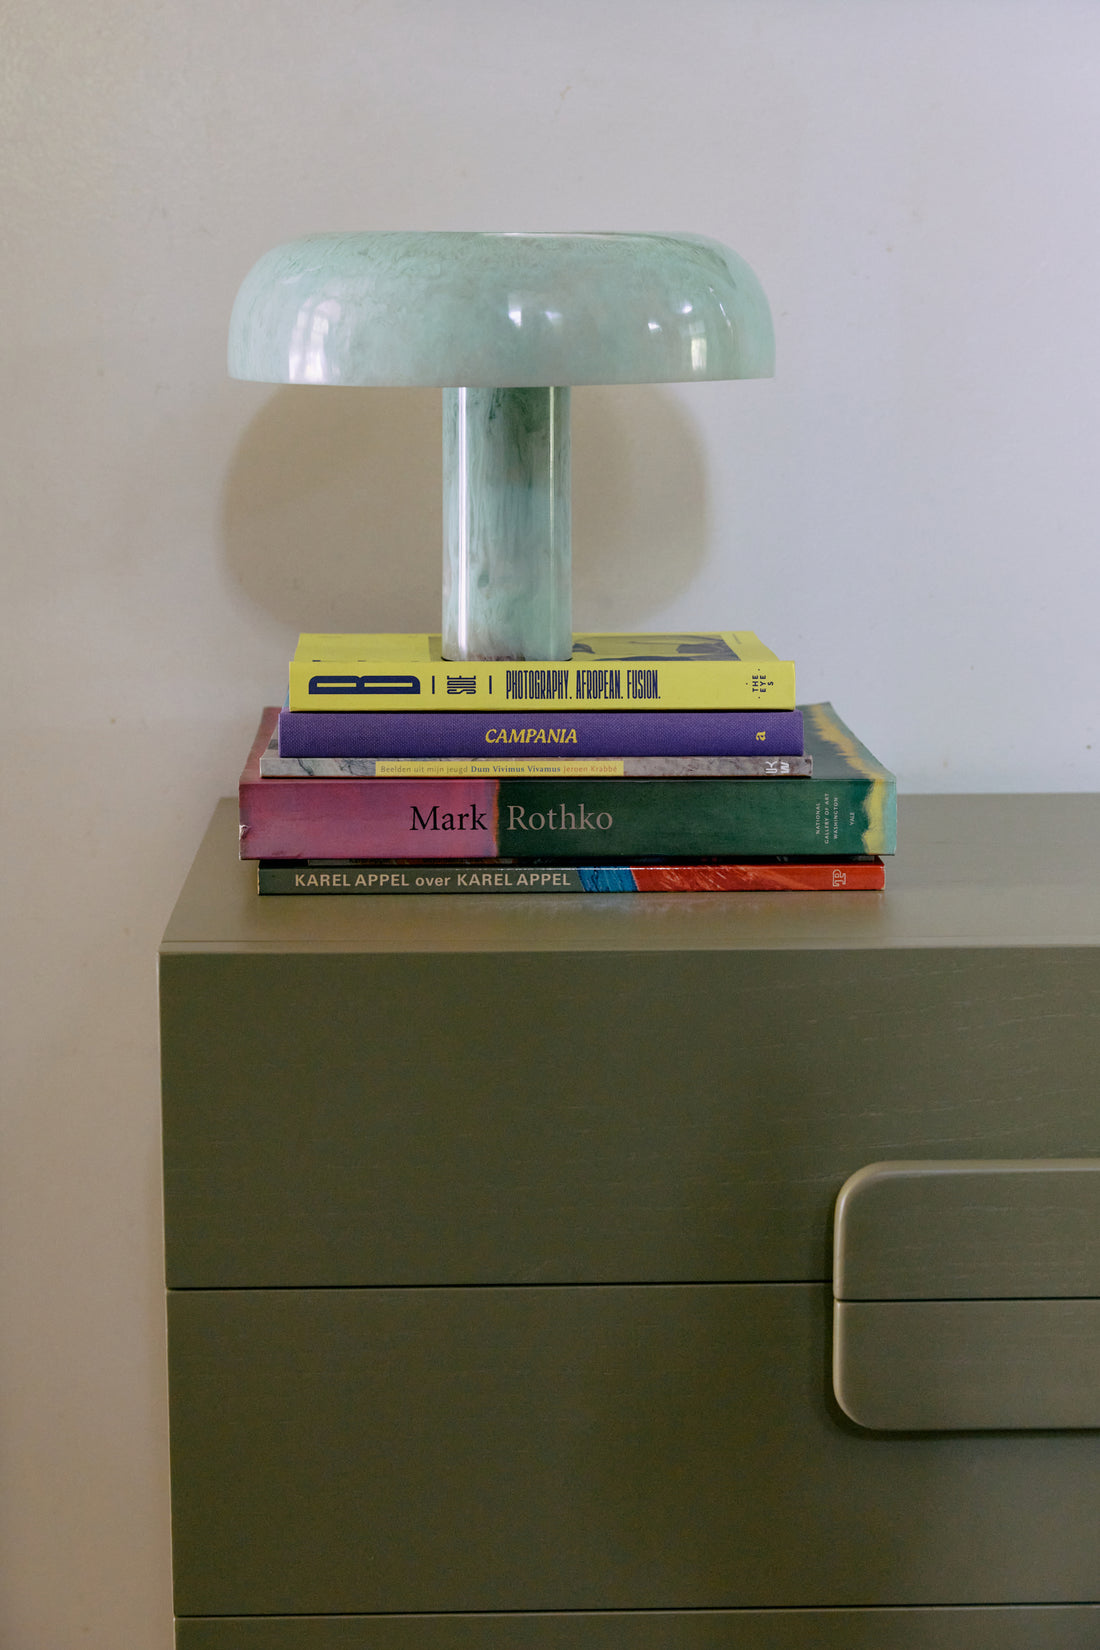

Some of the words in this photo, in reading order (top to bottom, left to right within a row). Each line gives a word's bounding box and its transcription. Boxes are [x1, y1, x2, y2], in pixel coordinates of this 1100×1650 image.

[308, 675, 421, 695] B
[446, 675, 477, 695] SIDE
[505, 669, 572, 700] PHOTOGRAPHY.
[576, 669, 624, 700] AFROPEAN.
[626, 669, 661, 700] FUSION.
[751, 674, 760, 693] THE
[484, 728, 578, 744] CAMPANIA
[755, 731, 767, 742] a
[380, 765, 412, 773] Beelden
[413, 765, 425, 773] uit
[426, 765, 445, 775] mijn
[446, 765, 469, 775] jeugd
[471, 765, 490, 773] Dum
[492, 765, 525, 773] Vivimus
[527, 765, 561, 773] Vivamus
[590, 764, 618, 773] Krabbé
[409, 803, 488, 831] Mark
[506, 803, 613, 831] Rothko
[824, 807, 830, 816] OF
[294, 873, 351, 887] KAREL
[355, 873, 410, 887] APPEL
[415, 876, 451, 887] over
[457, 873, 513, 886] KAREL
[516, 873, 571, 886] APPEL
